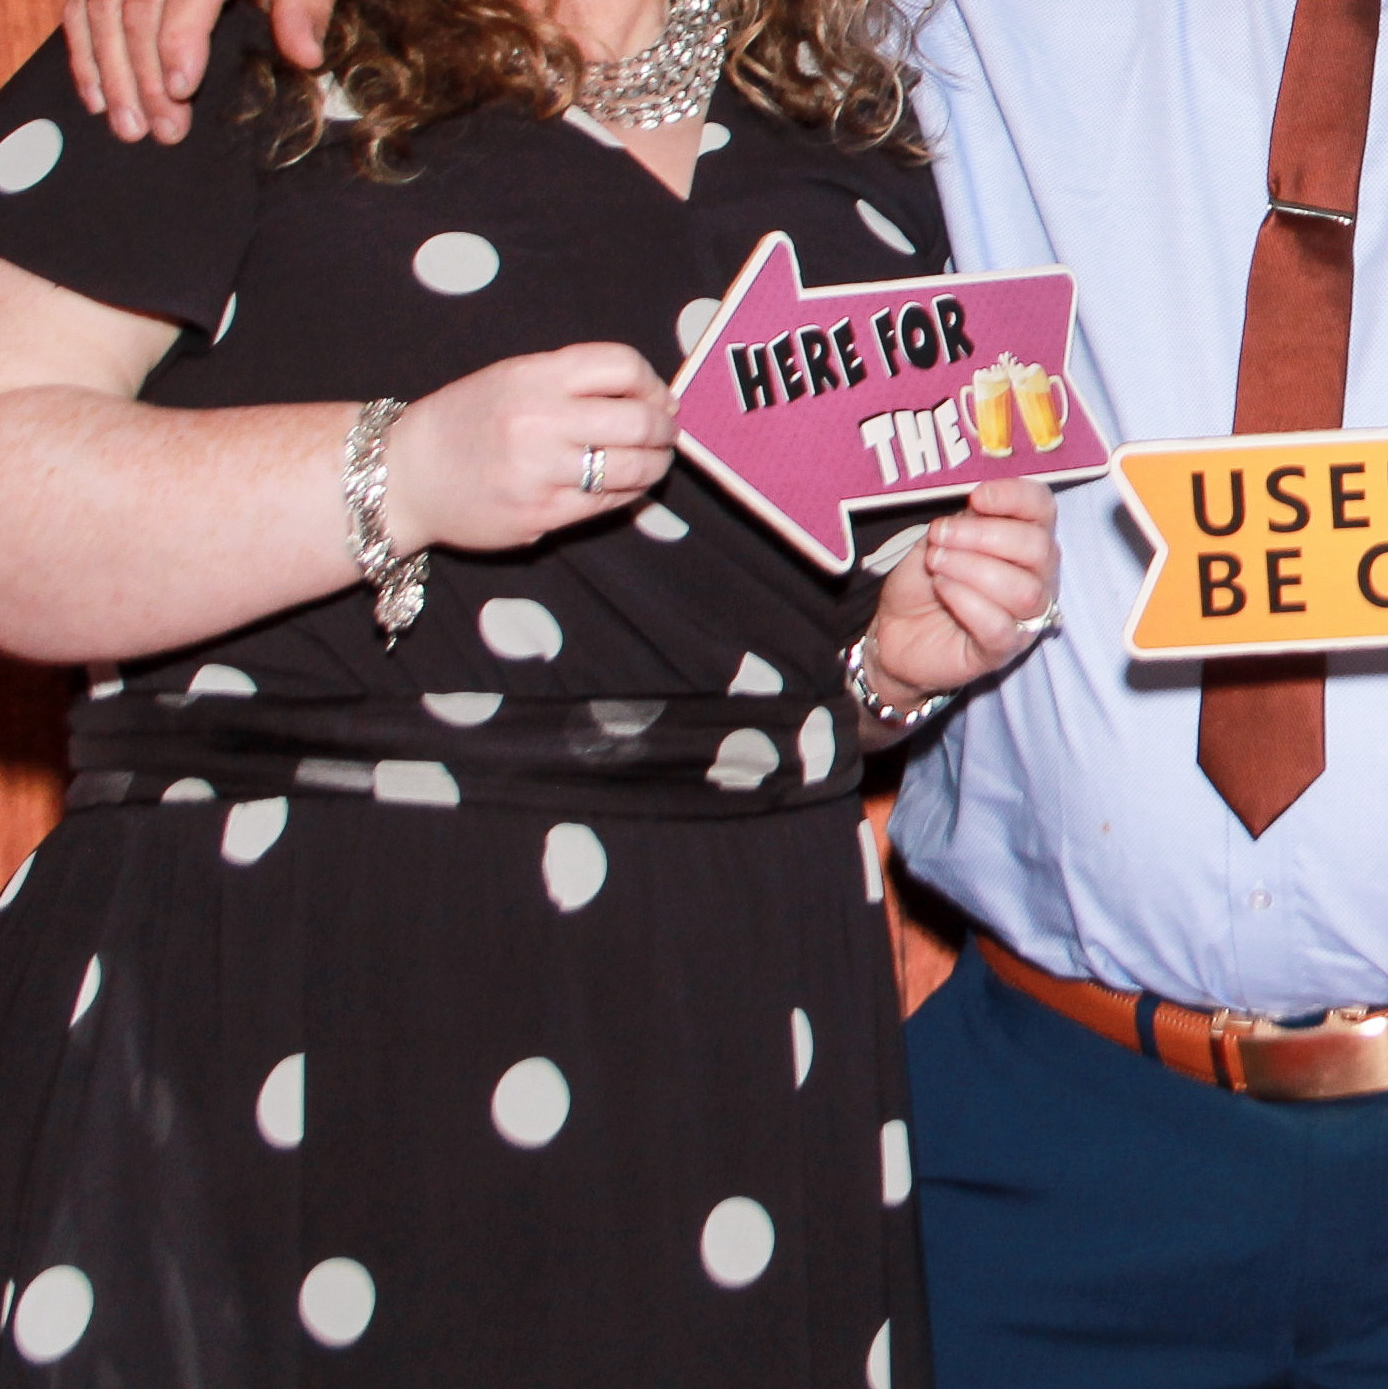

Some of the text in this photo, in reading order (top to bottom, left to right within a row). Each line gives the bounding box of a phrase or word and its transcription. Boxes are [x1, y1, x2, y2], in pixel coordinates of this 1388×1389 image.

[726, 293, 975, 413] HERE FOR
[859, 397, 973, 486] THE
[1197, 547, 1308, 619] BE
